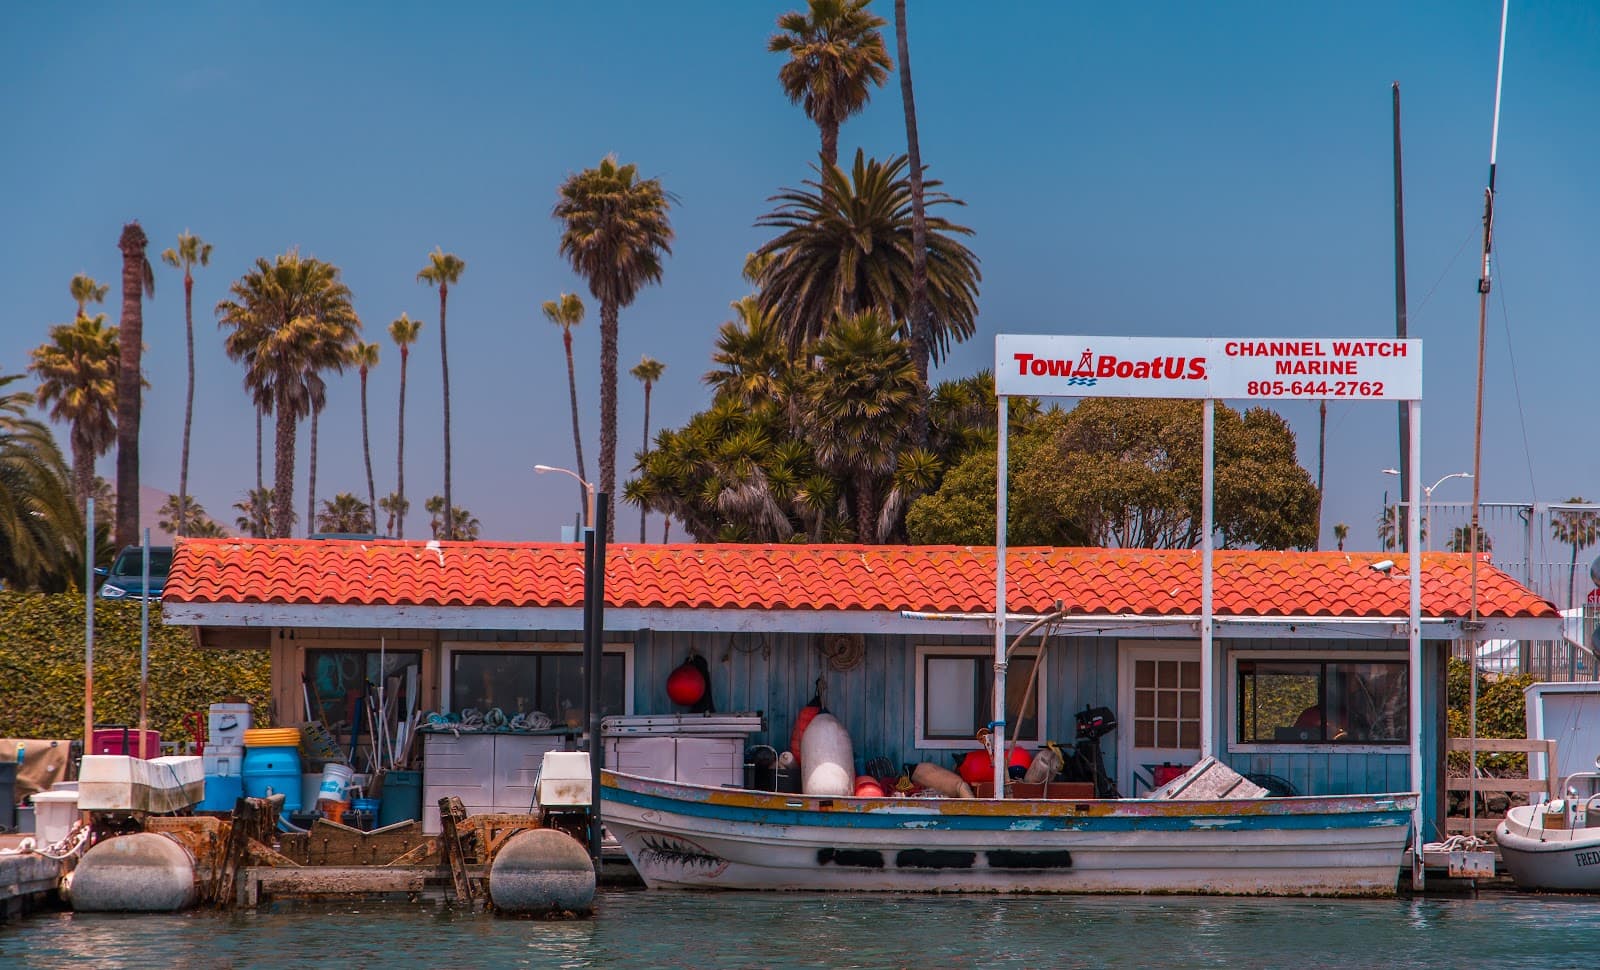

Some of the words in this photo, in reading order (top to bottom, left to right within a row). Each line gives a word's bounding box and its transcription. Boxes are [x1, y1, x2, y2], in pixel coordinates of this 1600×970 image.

[1225, 342, 1326, 357] CHANNEL
[1333, 342, 1407, 357] WATCH
[1014, 353, 1073, 377] Tow
[1275, 360, 1357, 375] MARINE
[1247, 381, 1384, 396] 805-644-2762
